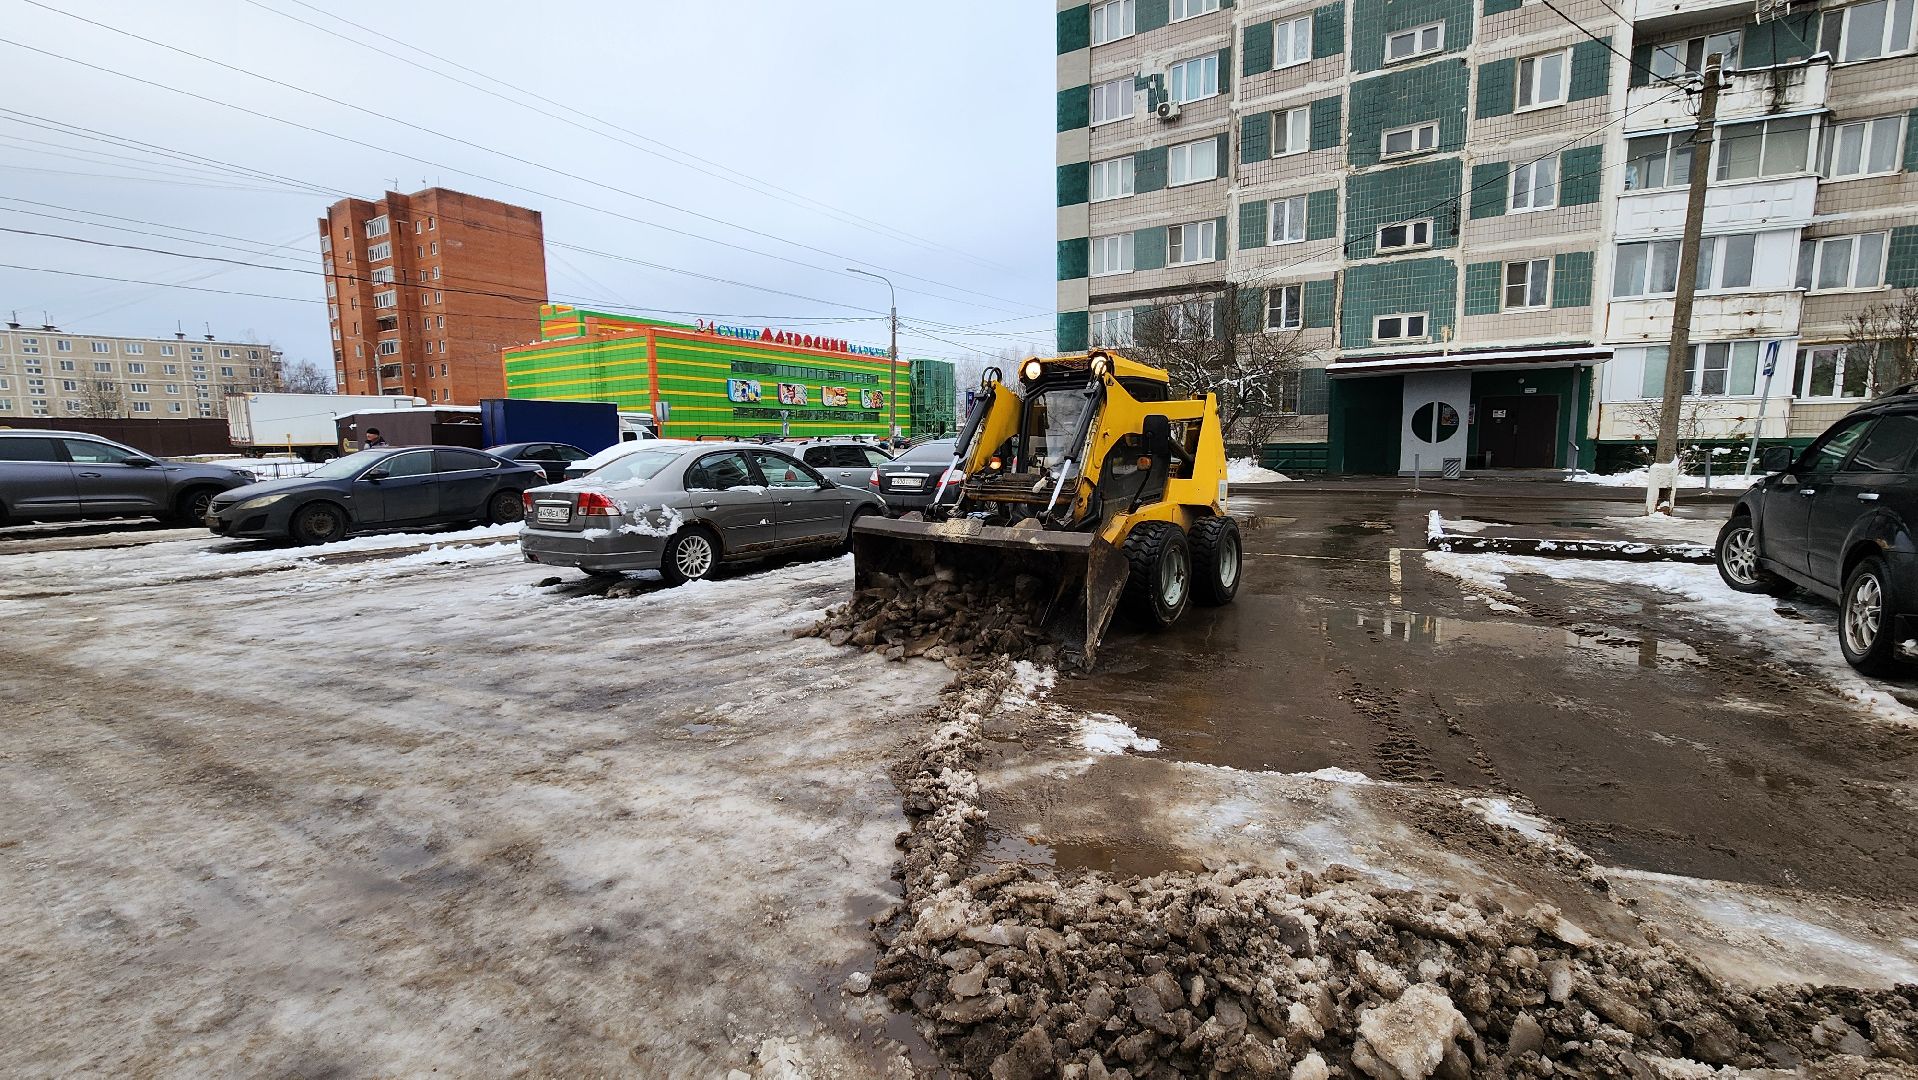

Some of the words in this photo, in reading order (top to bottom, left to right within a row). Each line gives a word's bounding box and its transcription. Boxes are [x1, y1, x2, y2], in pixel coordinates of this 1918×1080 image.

[694, 318, 714, 335] 24
[717, 324, 760, 341] СУПЕР
[760, 327, 848, 353] МАТРОСКИН
